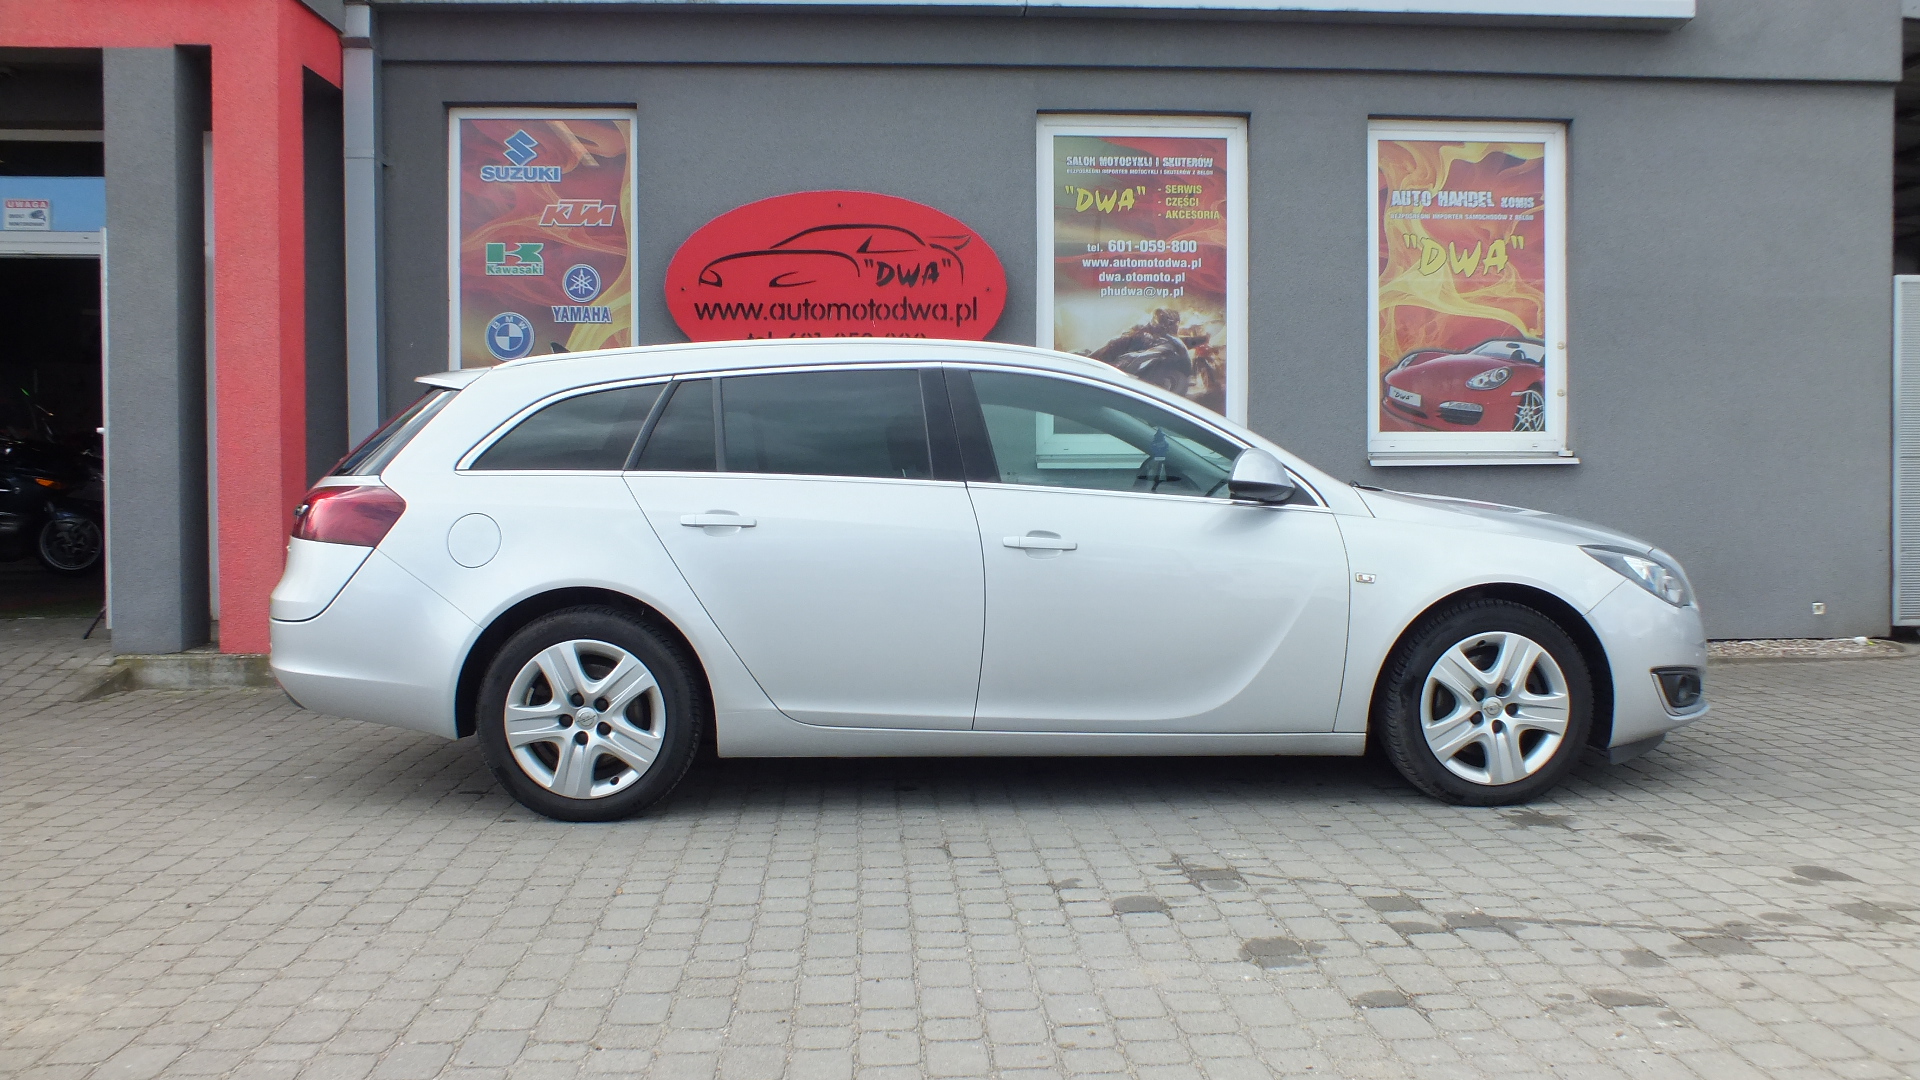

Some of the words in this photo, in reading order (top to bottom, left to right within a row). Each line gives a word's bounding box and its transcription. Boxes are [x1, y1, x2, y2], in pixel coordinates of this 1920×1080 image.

[1066, 156, 1096, 166] SALON
[1099, 156, 1153, 167] MOTOCYKLI
[1155, 157, 1160, 167] I
[1162, 154, 1214, 168] SKUTERÓW
[480, 166, 562, 182] SUZUKI
[1165, 184, 1203, 194] SERWIS
[1064, 185, 1146, 214] "DWA"
[1165, 195, 1199, 208] CZĘŚCI
[1391, 190, 1432, 207] AUTO
[1437, 190, 1495, 208] HANDEL
[1500, 197, 1535, 208] KOMIS
[538, 198, 617, 227] KTM
[1165, 210, 1221, 220] AKCESORIA
[1087, 243, 1104, 252] tel.
[1107, 239, 1198, 253] 601-059-800
[1403, 233, 1525, 278] "DWA"
[486, 264, 544, 275] Kawasaki
[1082, 257, 1202, 270] www.automotodwa.pl
[863, 257, 952, 288] "DWA"
[1098, 271, 1186, 283] dwa.otomoto.pl
[1100, 286, 1184, 298] phudwa@vp.pl
[552, 305, 613, 323] YAMAHA
[693, 296, 978, 328] www.automotodwa.pl
[490, 316, 528, 330] BMW
